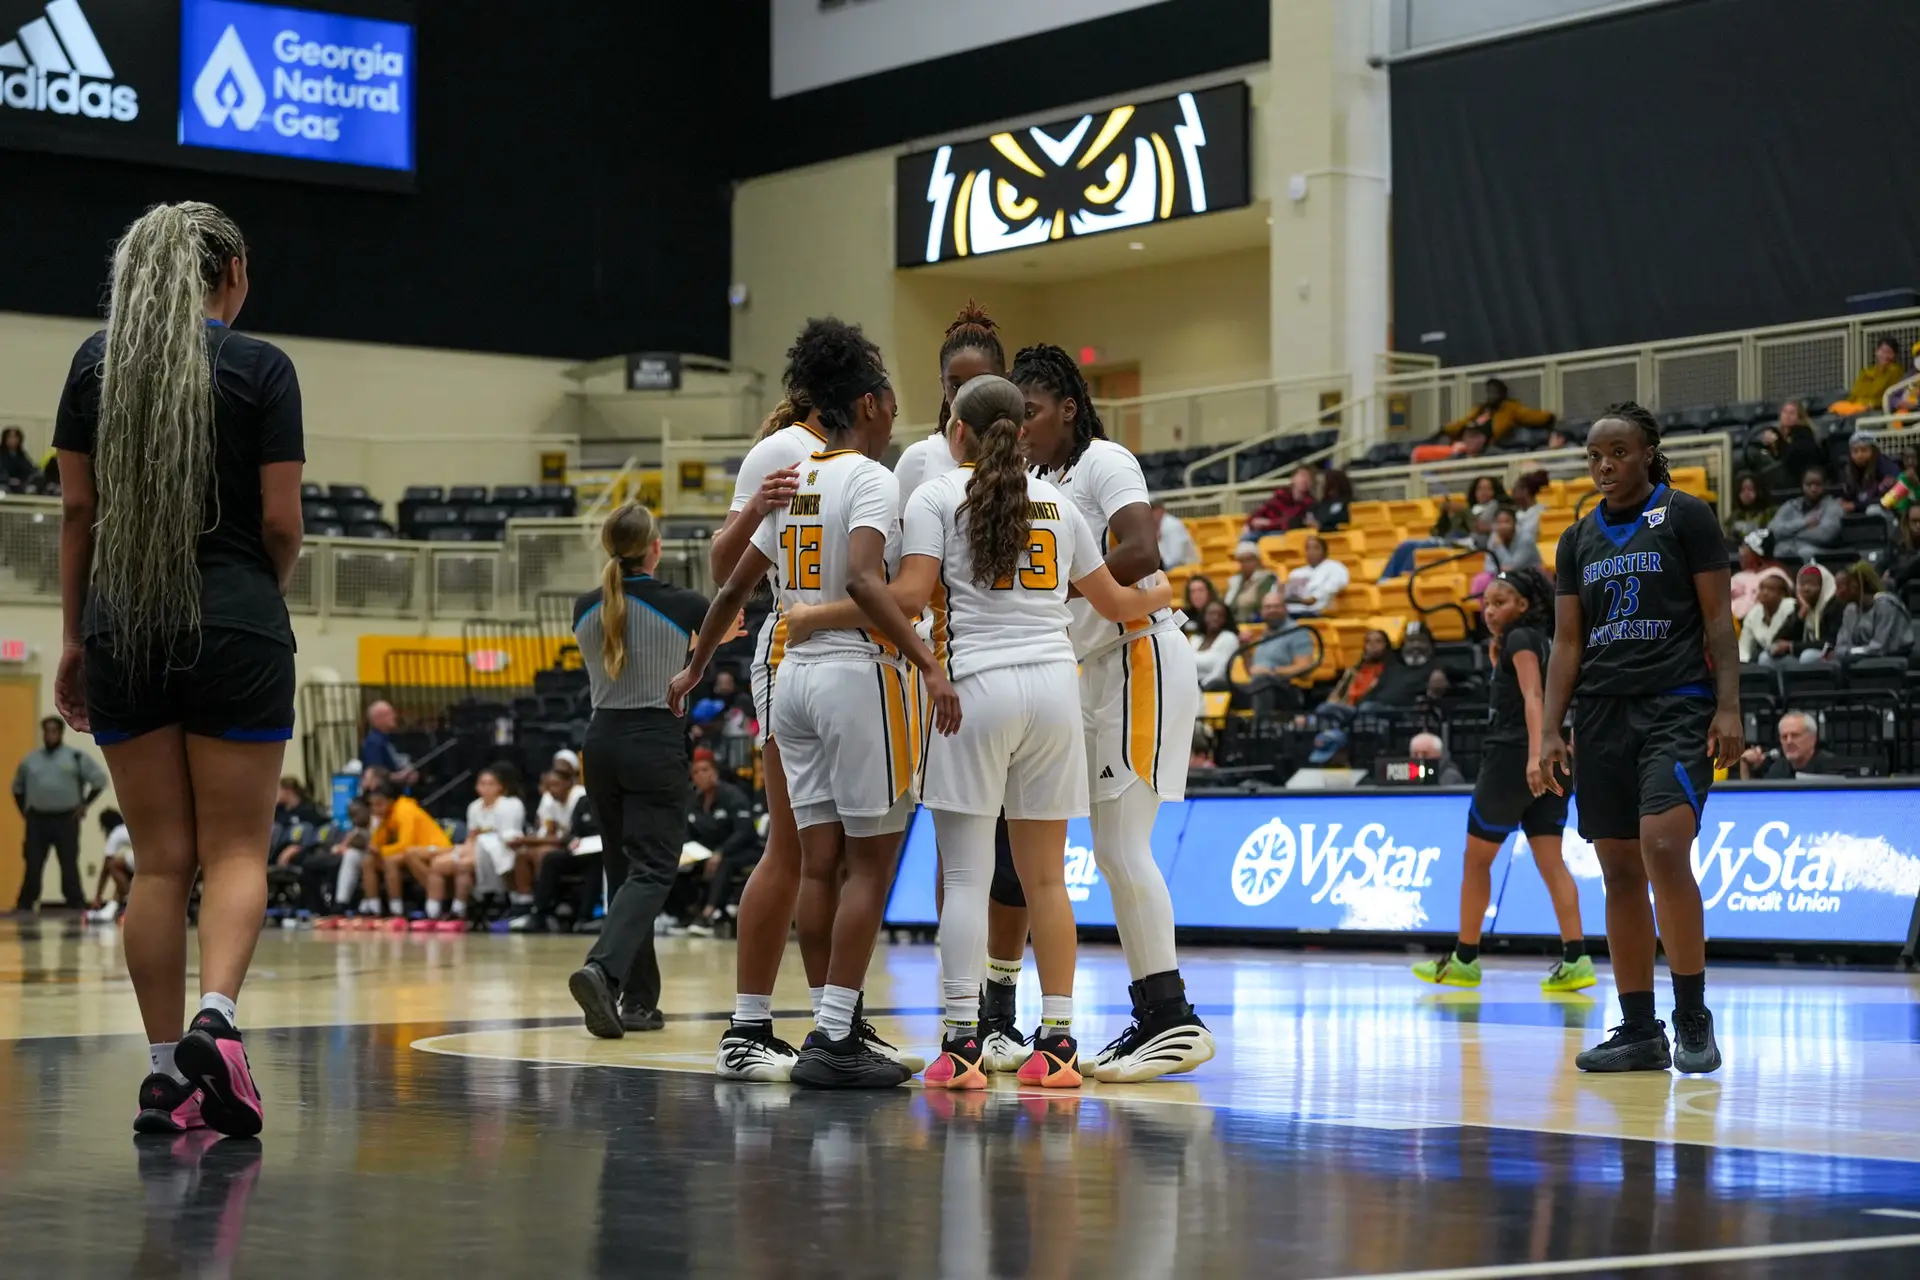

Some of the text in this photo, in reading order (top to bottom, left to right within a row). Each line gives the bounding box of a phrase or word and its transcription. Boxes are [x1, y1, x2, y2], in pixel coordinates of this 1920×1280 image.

[272, 29, 404, 80] Georgia
[0, 66, 139, 122] didas
[273, 67, 401, 114] Natural
[272, 104, 342, 142] Gas
[789, 494, 821, 516] FLOWERS
[1028, 501, 1061, 521] NNETT
[780, 525, 822, 590] 12
[990, 528, 1059, 591] 3
[1584, 552, 1662, 585] SHORTER
[1605, 576, 1640, 621] 23
[1299, 823, 1441, 904] VyStar
[1727, 890, 1840, 912] Credit Union
